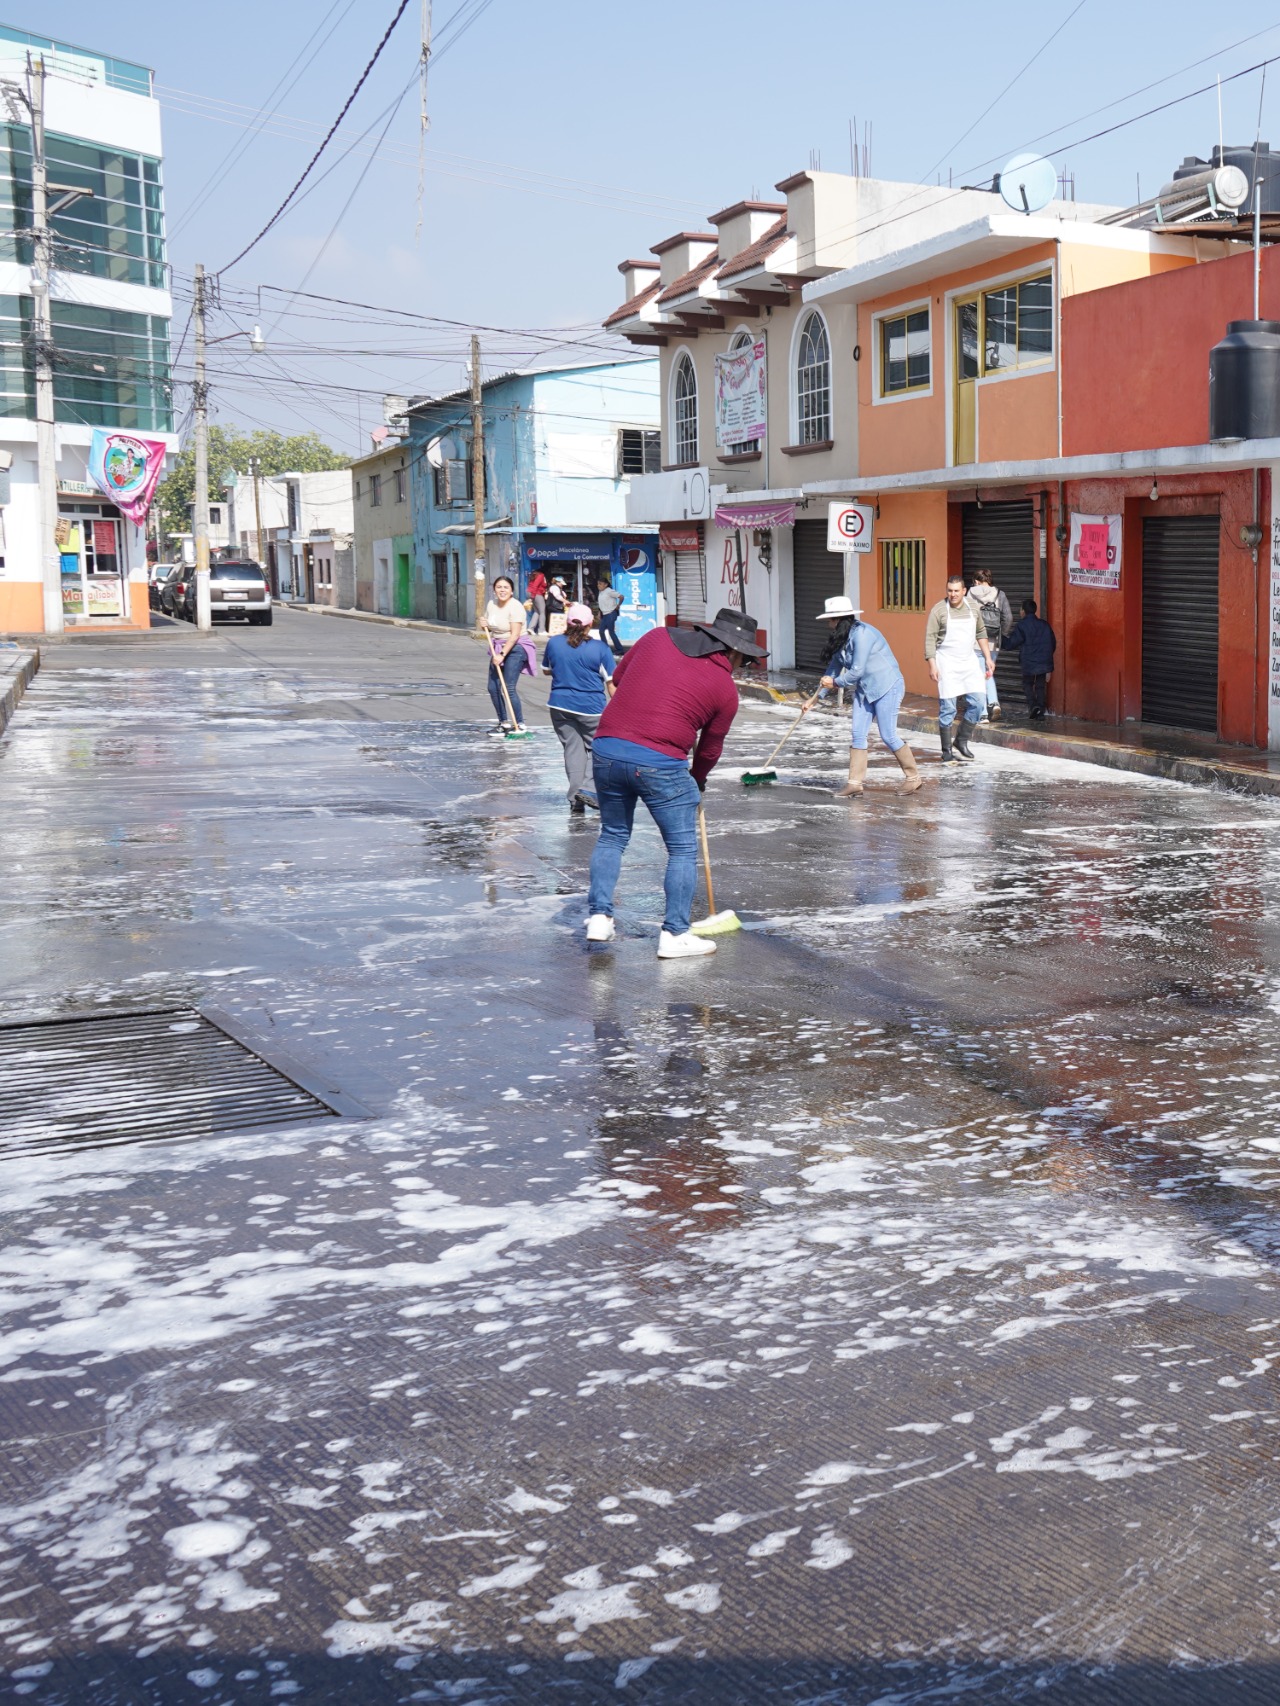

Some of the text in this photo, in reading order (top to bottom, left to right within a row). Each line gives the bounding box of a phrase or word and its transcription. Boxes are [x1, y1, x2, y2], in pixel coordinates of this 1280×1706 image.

[845, 514, 857, 533] E
[537, 549, 559, 558] pepsi
[720, 533, 749, 585] Red
[629, 579, 641, 605] pepsi
